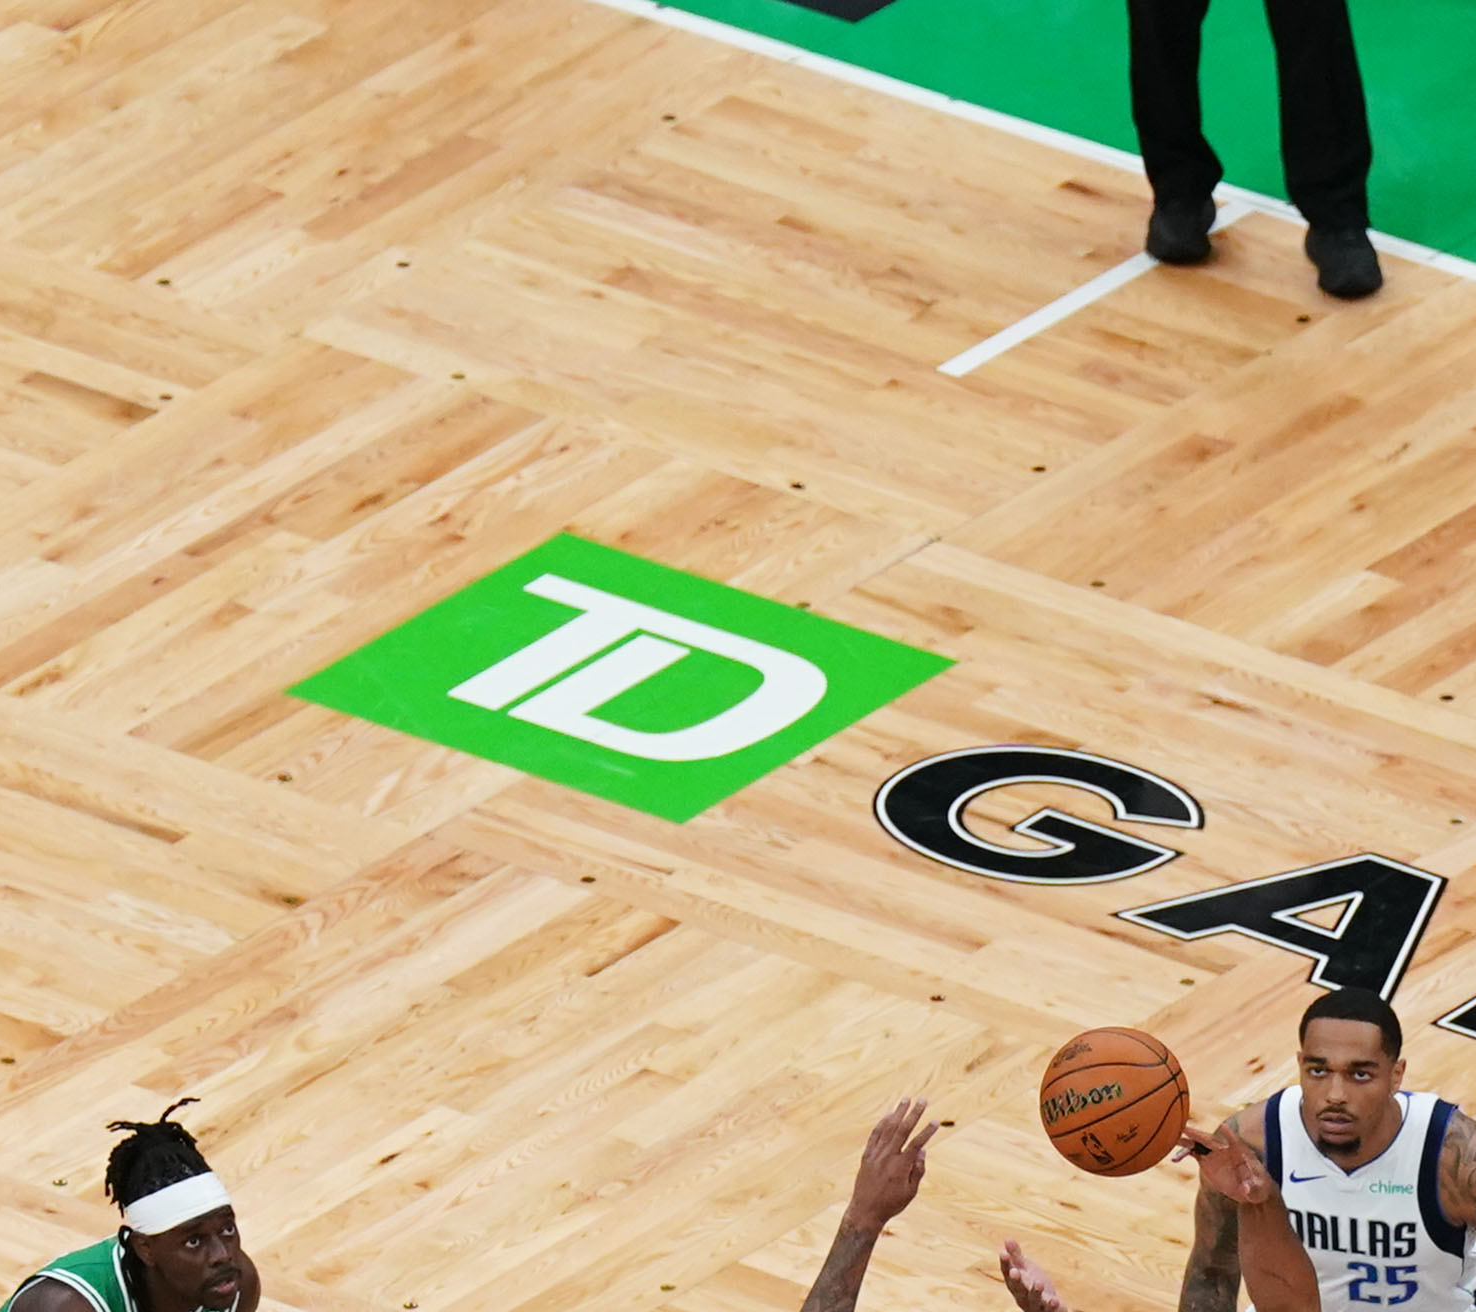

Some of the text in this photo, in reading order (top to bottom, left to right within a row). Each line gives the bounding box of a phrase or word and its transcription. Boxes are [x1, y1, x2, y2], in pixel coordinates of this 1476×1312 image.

[446, 572, 828, 762] TD
[1369, 1180, 1414, 1195] chime
[1346, 1261, 1419, 1306] 25
